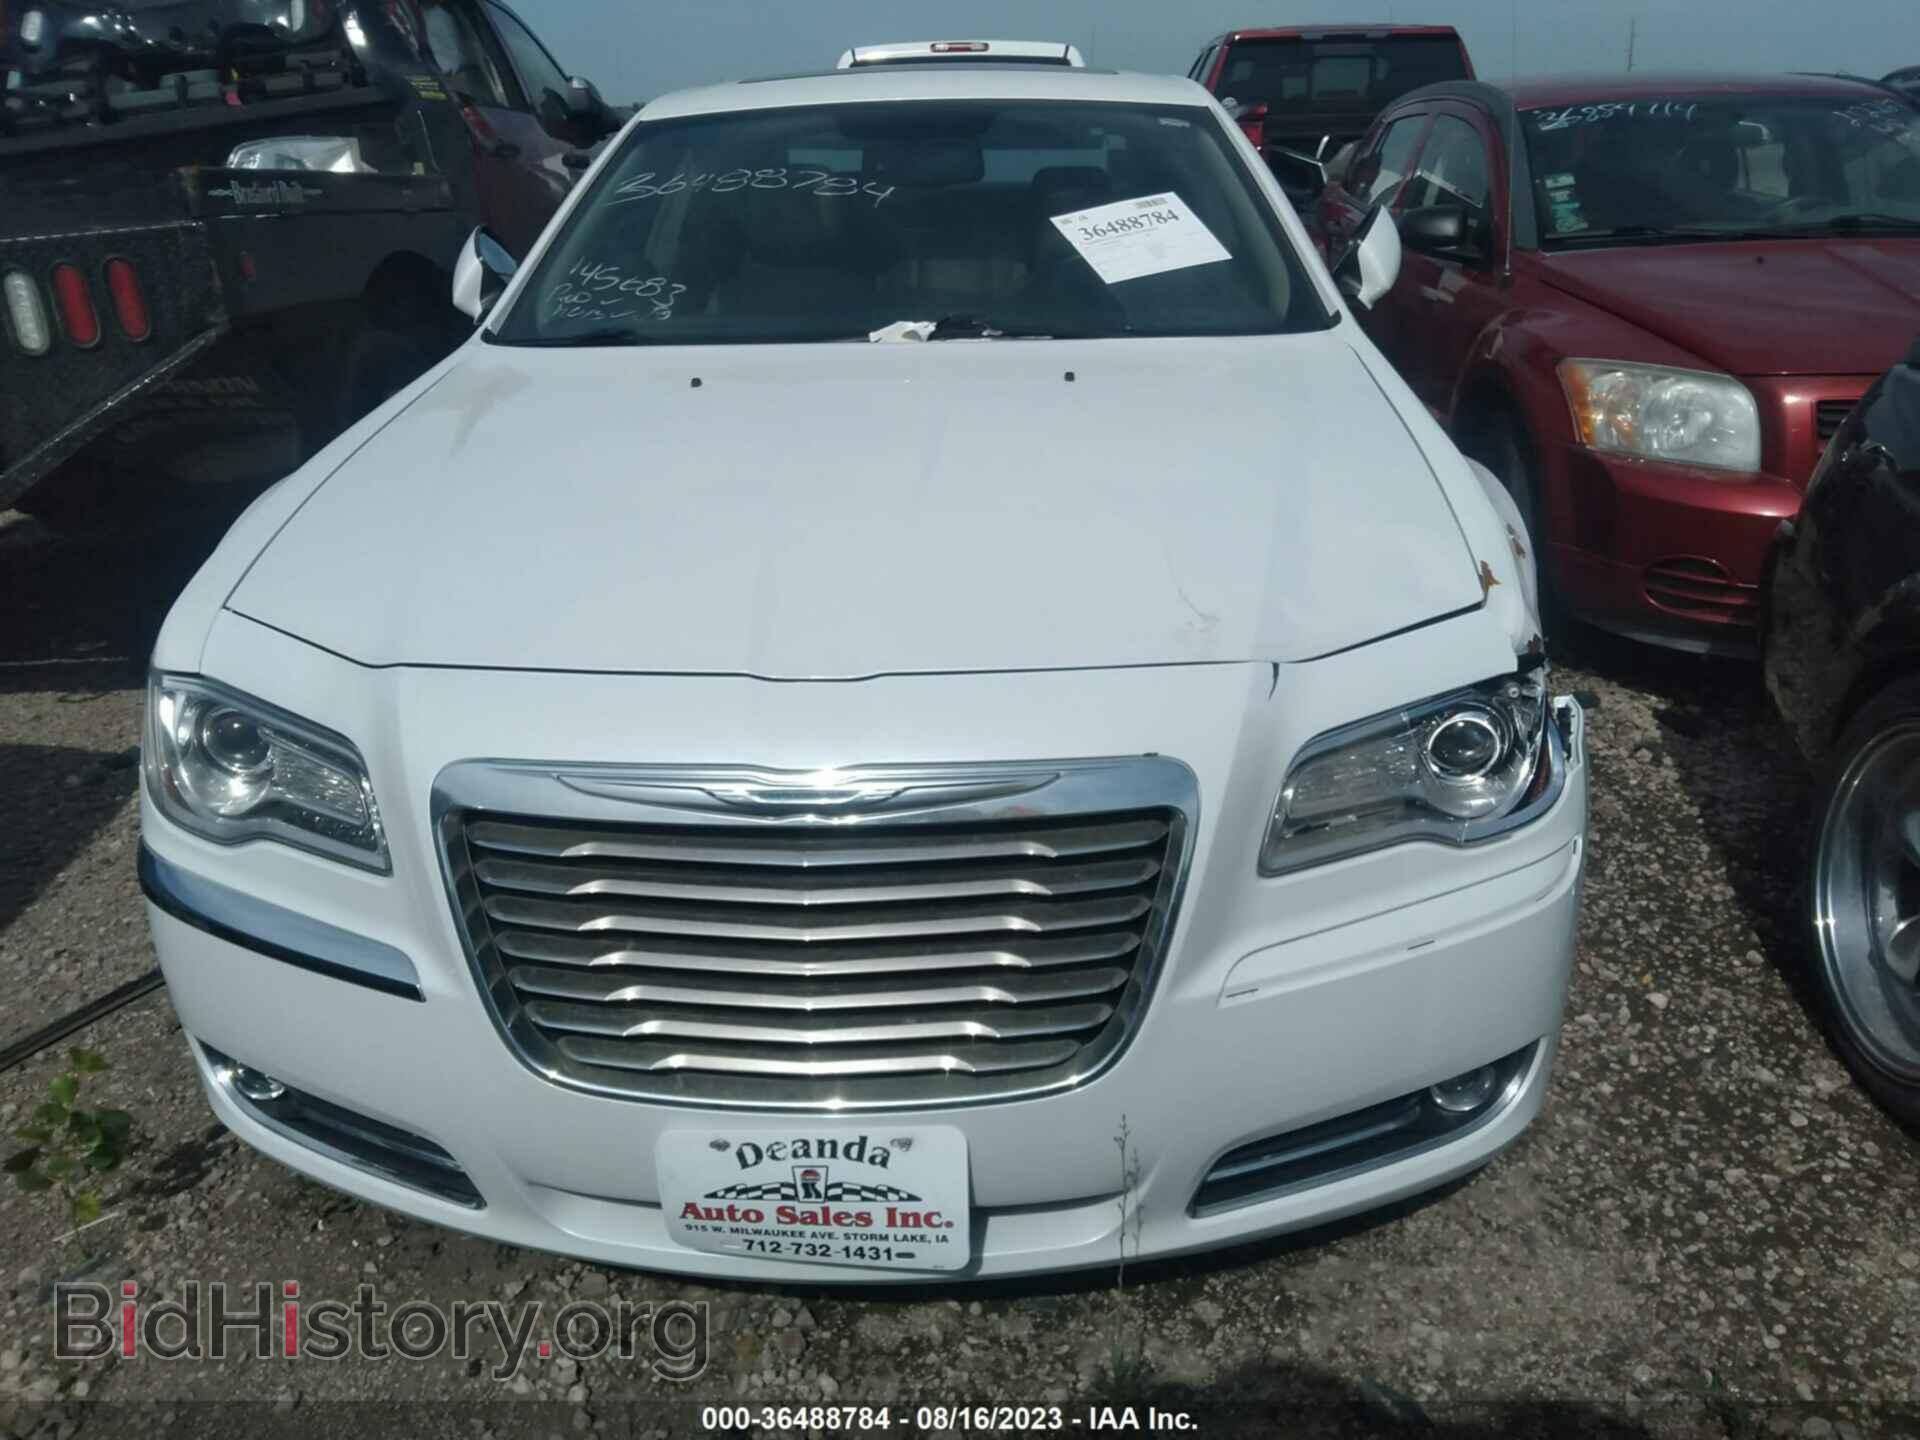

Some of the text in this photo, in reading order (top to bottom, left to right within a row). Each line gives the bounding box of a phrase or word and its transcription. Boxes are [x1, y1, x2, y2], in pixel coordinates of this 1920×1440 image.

[1078, 209, 1179, 241] 36488784
[736, 1136, 891, 1170] Deanda
[680, 1202, 954, 1229] Auto Sales Inc.
[711, 1226, 727, 1234] W.
[730, 1226, 806, 1239] MILWAUKEE
[810, 1231, 838, 1240] AVE.
[844, 1232, 890, 1242] STORM
[894, 1234, 932, 1244] LAKE,
[936, 1235, 949, 1243] IA
[743, 1239, 893, 1261] 712-732-1431
